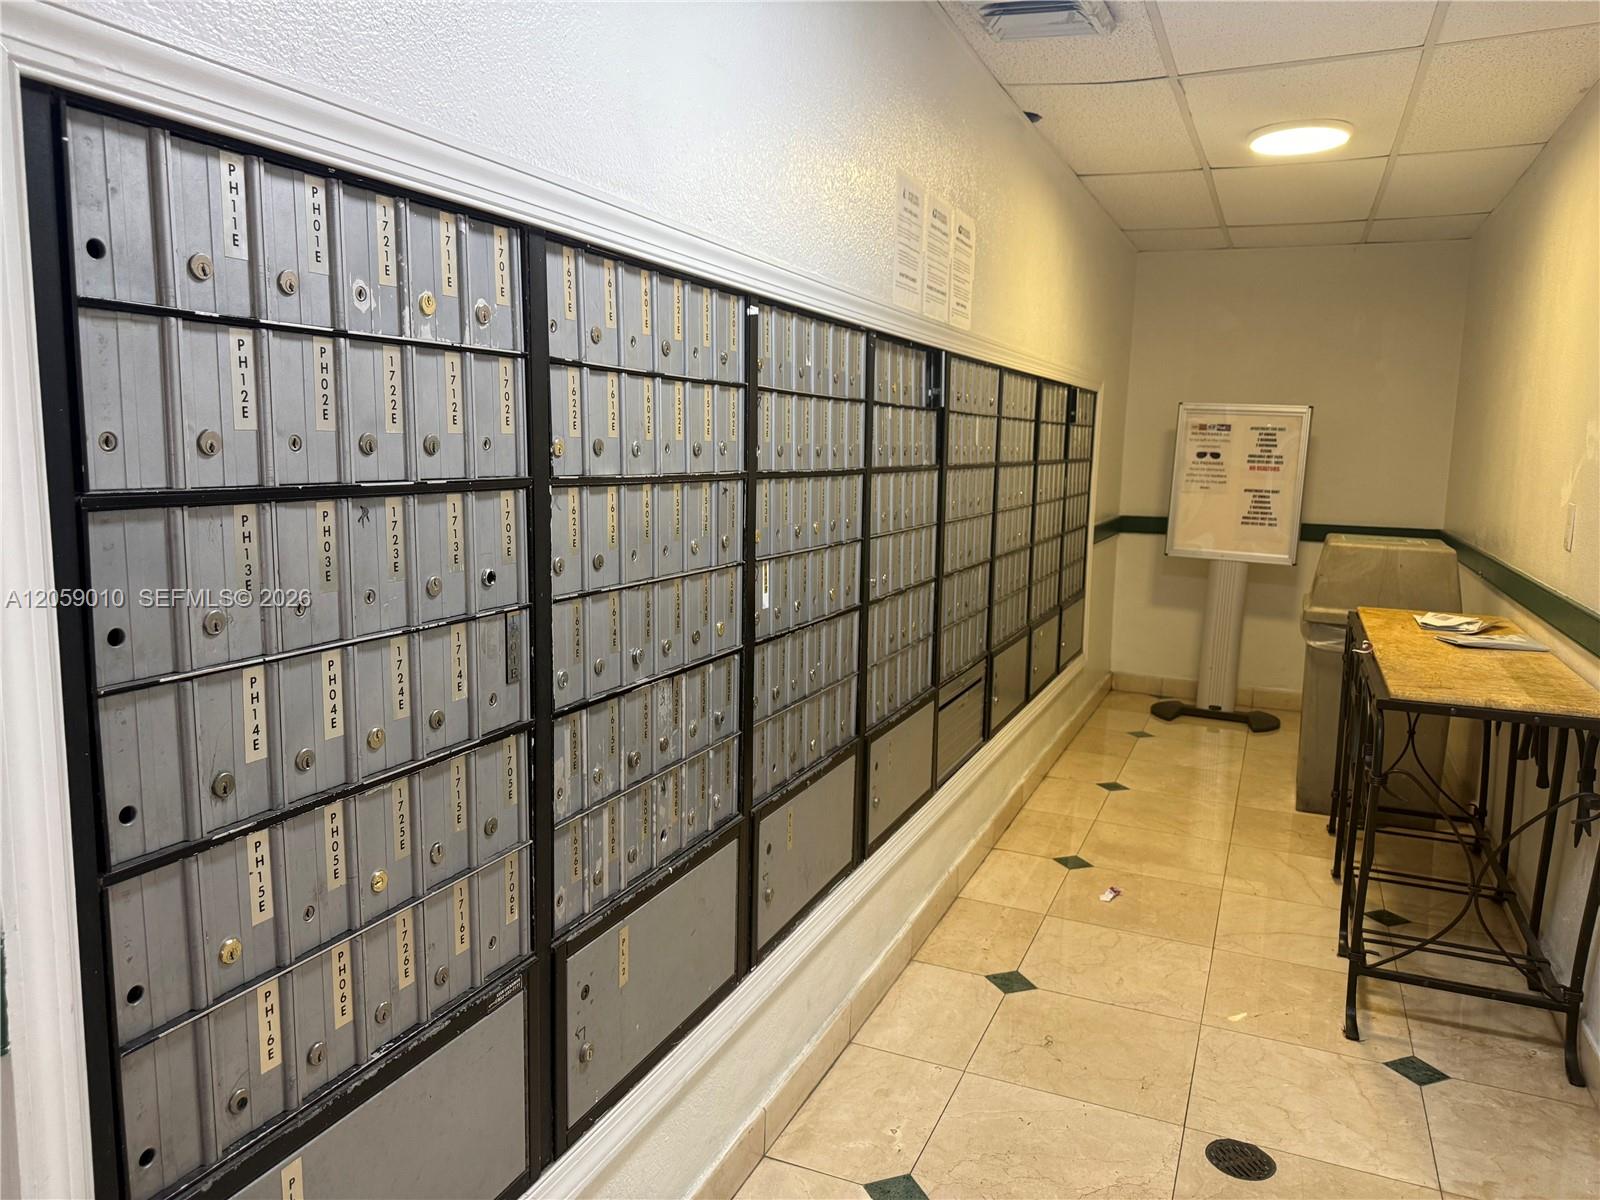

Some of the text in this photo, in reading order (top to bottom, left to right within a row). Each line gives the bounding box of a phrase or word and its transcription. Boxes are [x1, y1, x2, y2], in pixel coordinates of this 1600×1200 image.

[228, 163, 239, 247] PH11E
[311, 185, 321, 263] PH01E
[382, 205, 391, 276] 1721E
[237, 339, 249, 419] PH12E
[320, 346, 329, 421] PH02E
[241, 515, 252, 592] PH13E
[322, 510, 332, 582] PH03E
[250, 676, 260, 751] PH14E
[328, 660, 337, 729] PH04E
[397, 646, 405, 710] 1724E
[254, 840, 265, 913] PH15E
[330, 812, 339, 880] PH05E
[338, 951, 347, 1017] PH06E
[264, 990, 275, 1061] PH16E
